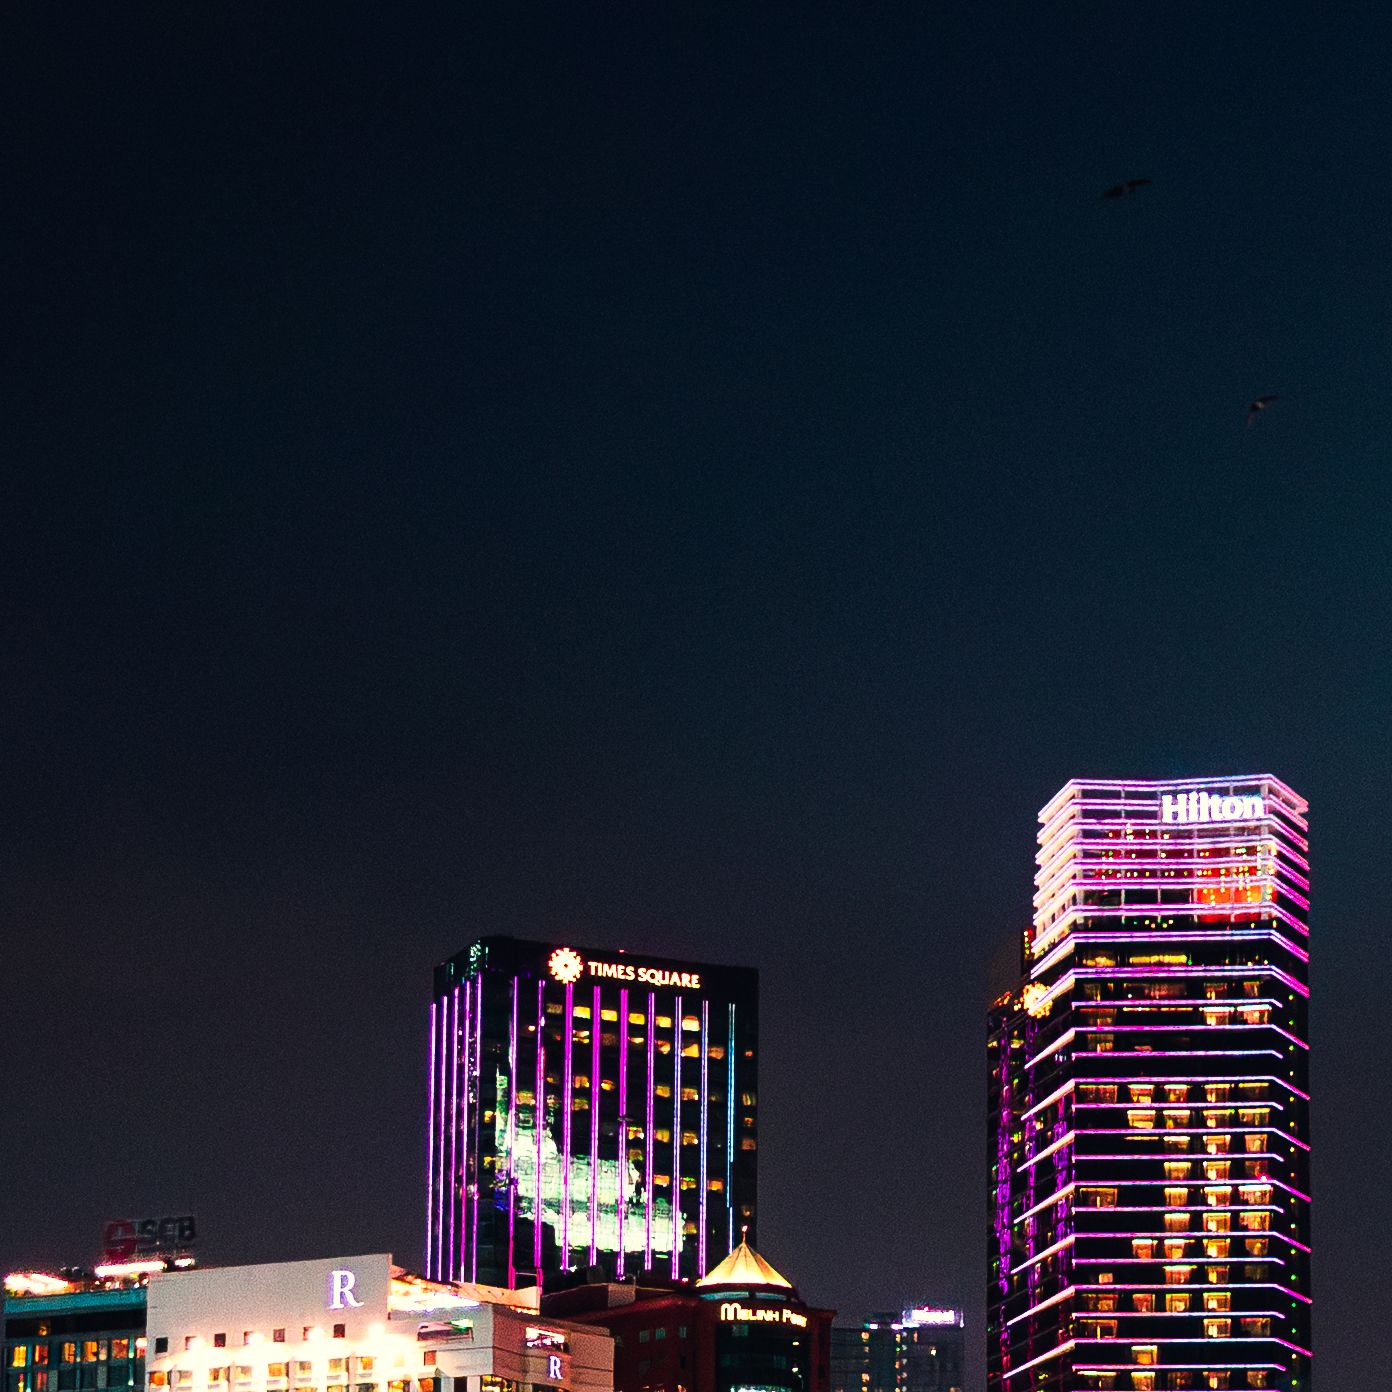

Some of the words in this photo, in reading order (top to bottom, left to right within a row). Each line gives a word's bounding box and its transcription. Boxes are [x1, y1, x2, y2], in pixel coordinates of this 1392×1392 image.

[1161, 791, 1264, 823] Hilton
[587, 961, 636, 981] TIMES
[637, 967, 701, 989] SQUARE
[329, 1270, 364, 1309] R
[549, 1355, 563, 1380] R
